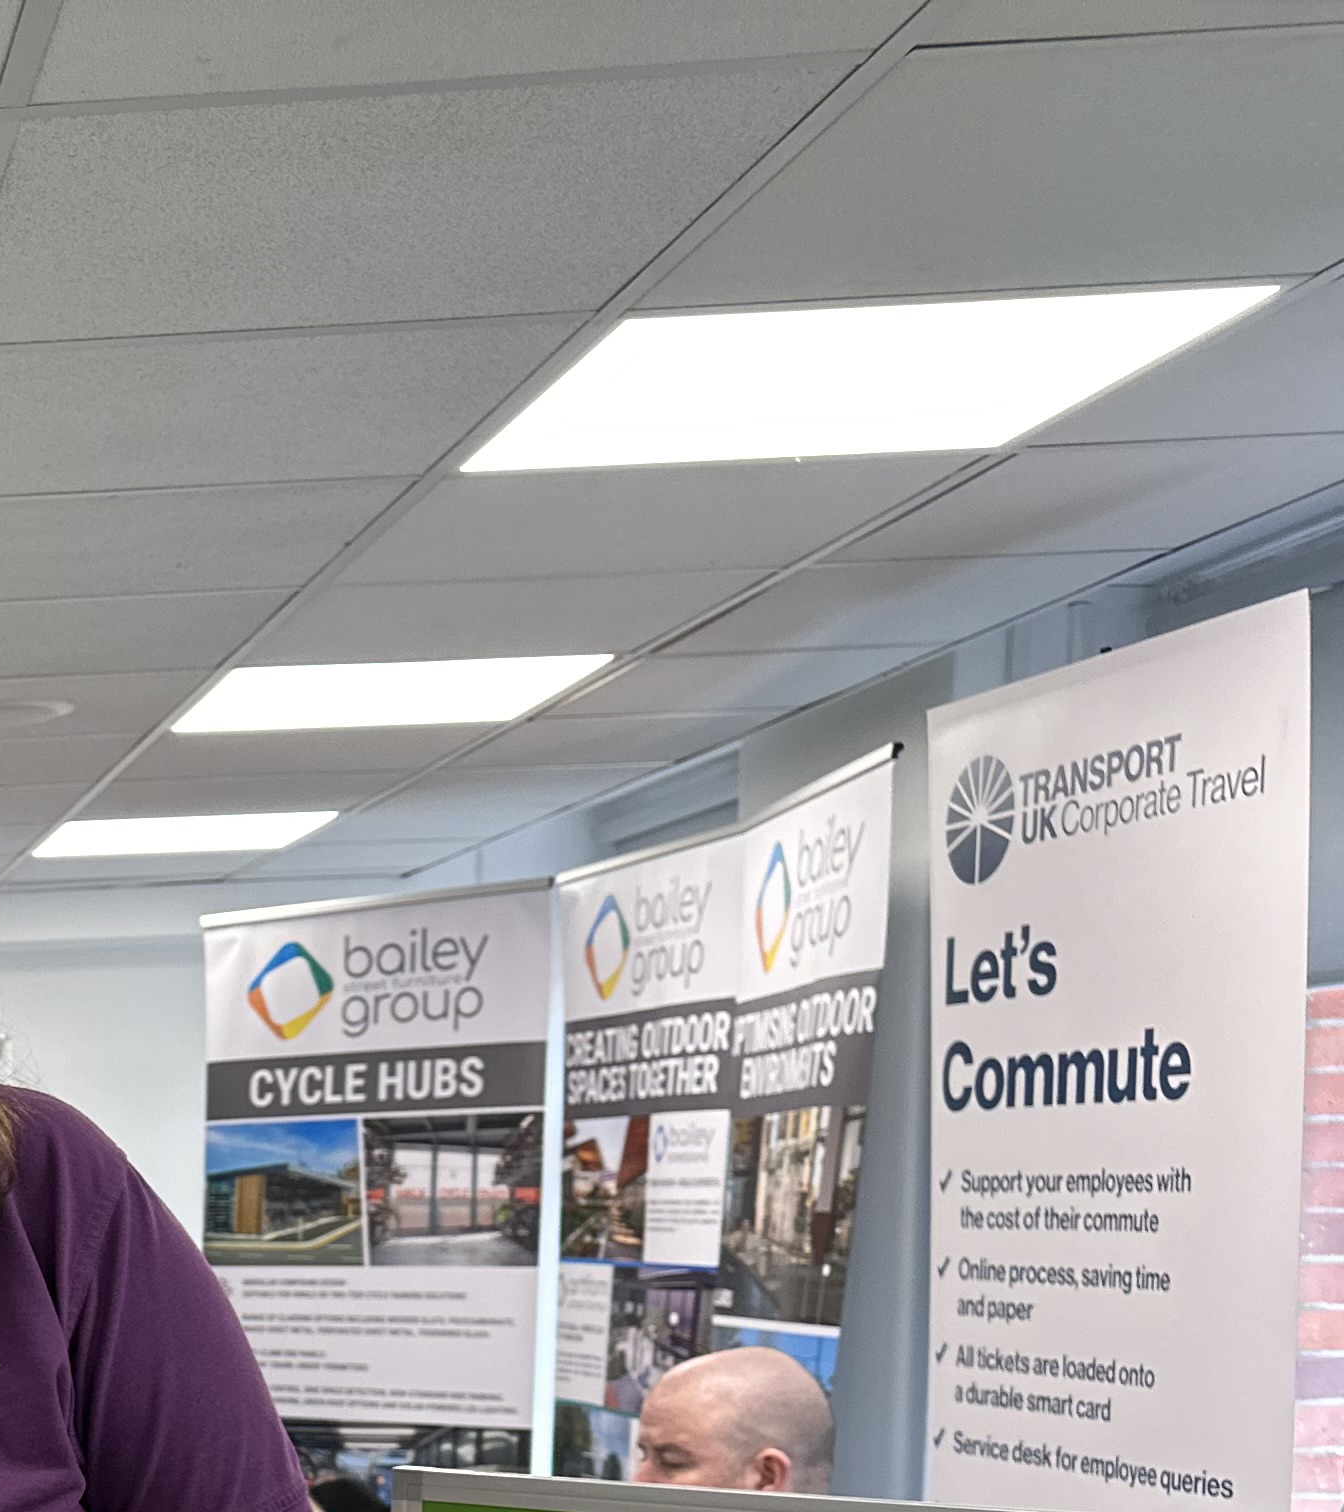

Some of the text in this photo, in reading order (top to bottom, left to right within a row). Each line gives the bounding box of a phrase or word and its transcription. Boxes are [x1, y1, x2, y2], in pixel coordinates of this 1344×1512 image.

[1020, 733, 1182, 807] TRANSPORT
[1022, 753, 1267, 845] UK Corporate Travel
[634, 876, 712, 933] bailey
[344, 927, 489, 981] bailey
[342, 986, 484, 1037] group
[249, 1056, 485, 1108] CYCLE HUBS
[943, 1027, 1191, 1111] Commute
[961, 1167, 1191, 1198] Support your employees with
[961, 1206, 1160, 1233] the cost of their commute
[958, 1256, 1170, 1294] Online process, saving time
[957, 1295, 1034, 1324] and paper
[955, 1344, 1155, 1389] All tickets are loaded onto
[954, 1382, 1112, 1422] a durable smart card
[953, 1430, 1233, 1499] Service desk for employee queries
